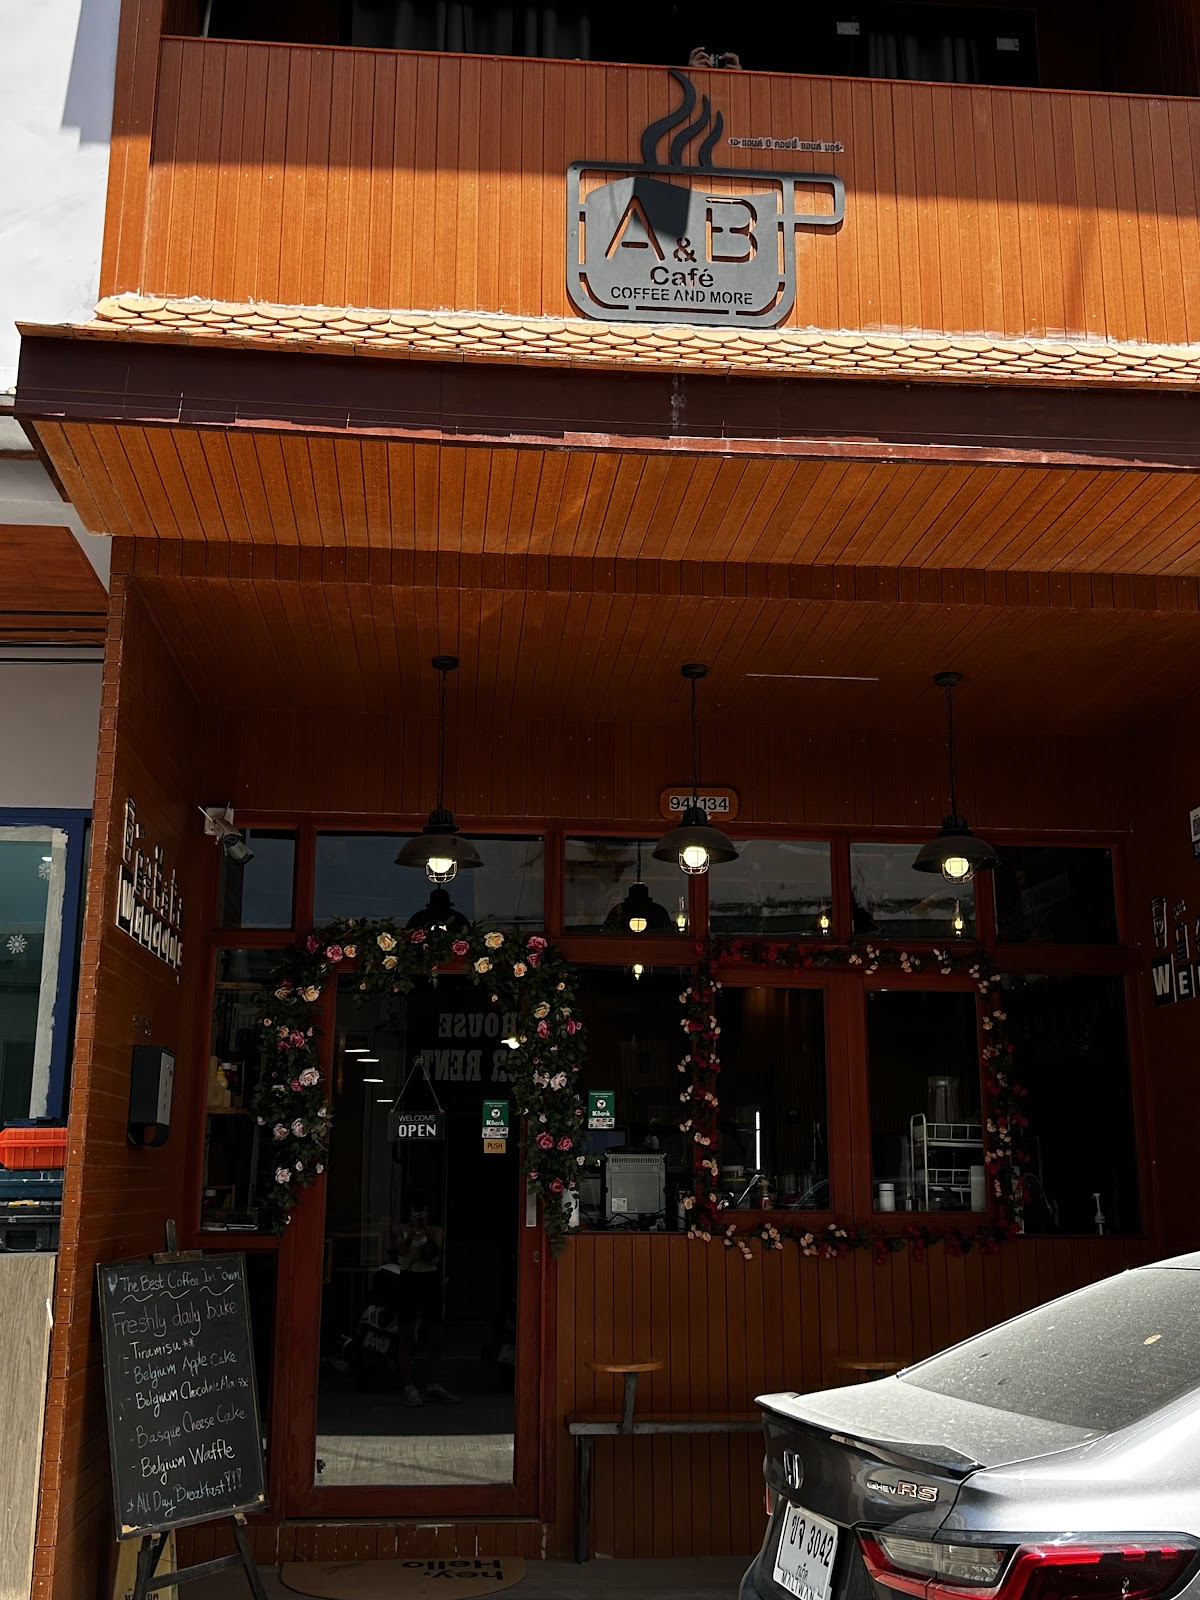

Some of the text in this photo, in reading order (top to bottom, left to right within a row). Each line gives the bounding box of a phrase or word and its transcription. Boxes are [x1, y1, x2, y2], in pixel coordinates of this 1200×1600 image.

[649, 265, 714, 288] Café
[610, 286, 753, 305] COFFEE AND MORE
[398, 1114, 436, 1122] WELCOME
[398, 1124, 437, 1138] OPEN
[487, 1142, 503, 1150] PUSH
[119, 1276, 139, 1293] The
[140, 1274, 165, 1292] Best
[168, 1271, 200, 1289] Coffee
[112, 1297, 238, 1338] Freshly daily bake
[134, 1350, 238, 1388] Belgium Apple Cake
[135, 1388, 179, 1418] Belgium
[135, 1402, 248, 1448] Basque Cheese Cake
[140, 1438, 236, 1485] Belgium Waffle
[897, 1480, 938, 1502] RS
[153, 1490, 177, 1518] Day
[807, 1525, 834, 1568] 3042
[402, 1559, 502, 1570] Hello
